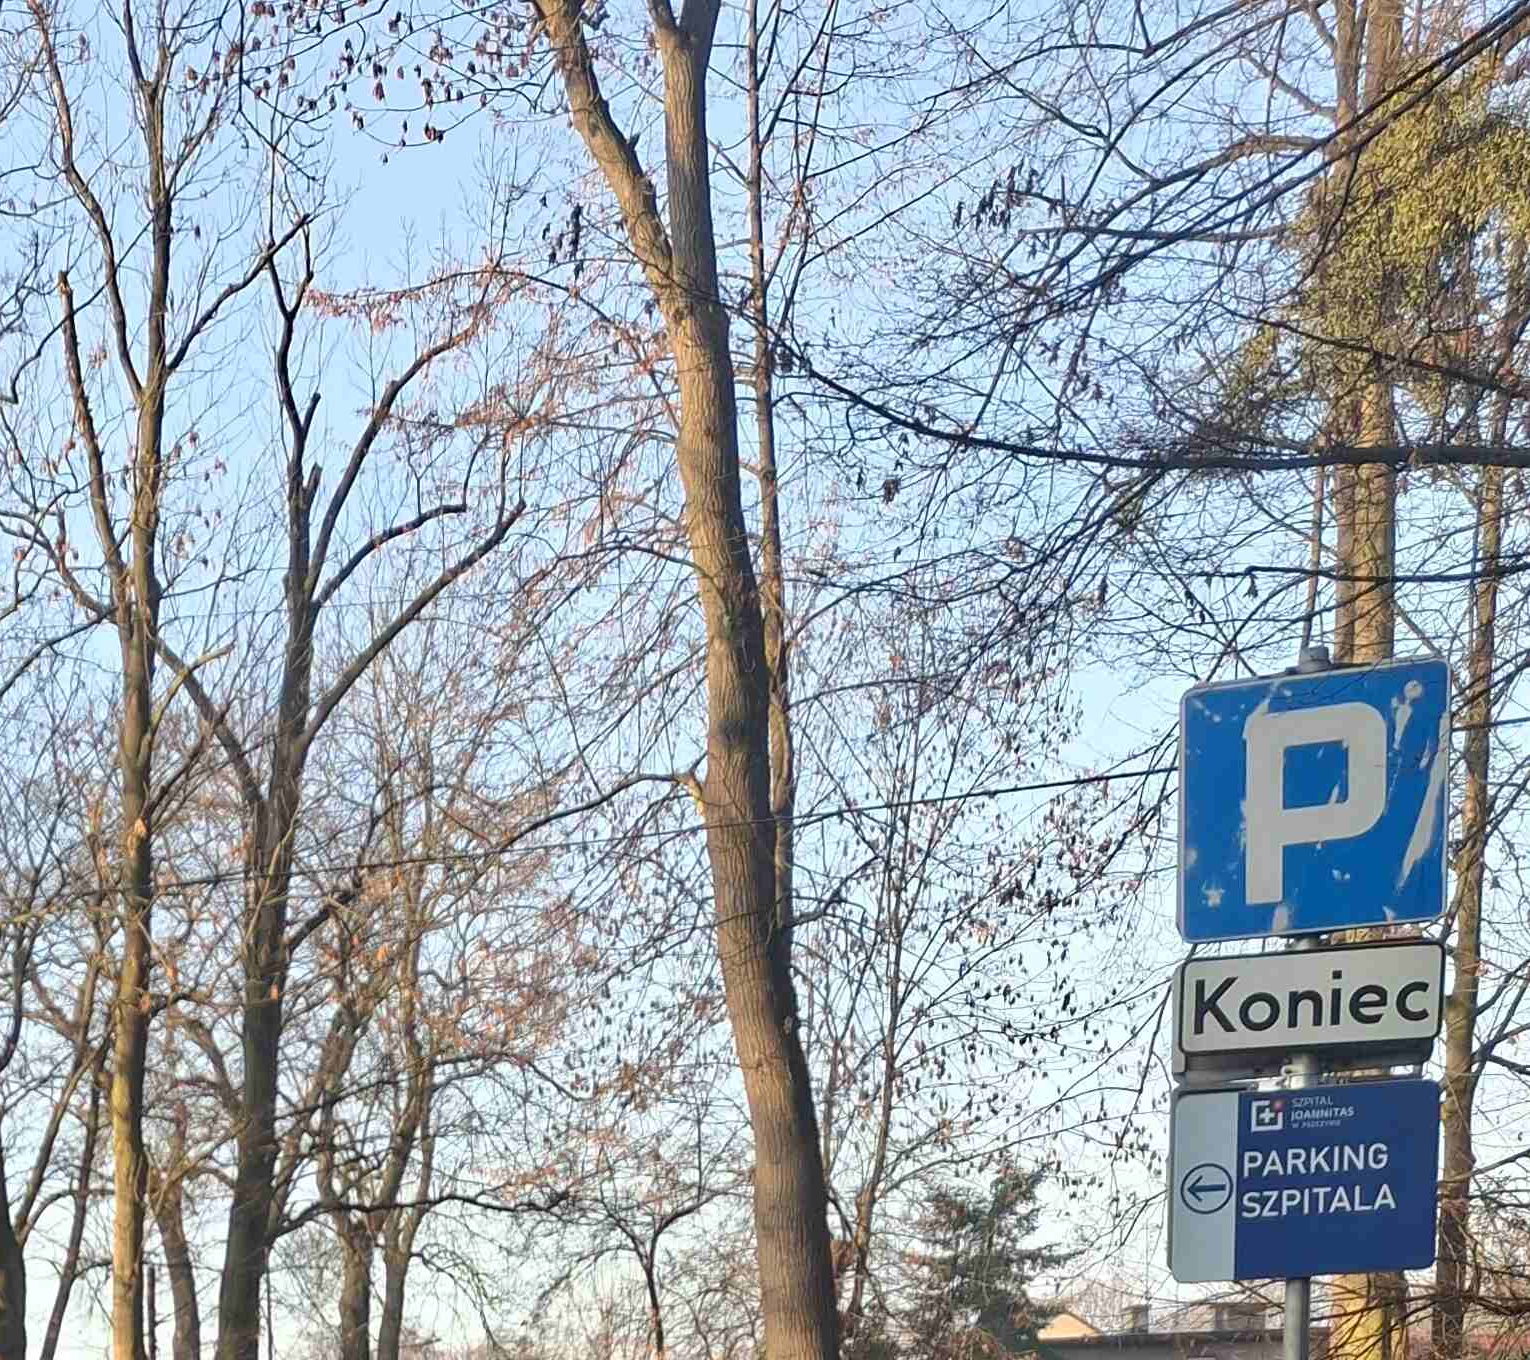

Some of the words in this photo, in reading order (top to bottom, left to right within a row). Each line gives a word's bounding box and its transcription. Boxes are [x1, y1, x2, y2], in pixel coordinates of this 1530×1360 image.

[1244, 701, 1387, 905] P
[1193, 969, 1430, 1036] Koniec
[1243, 1142, 1389, 1179] PARKING
[1241, 1183, 1397, 1218] SZPITALA
